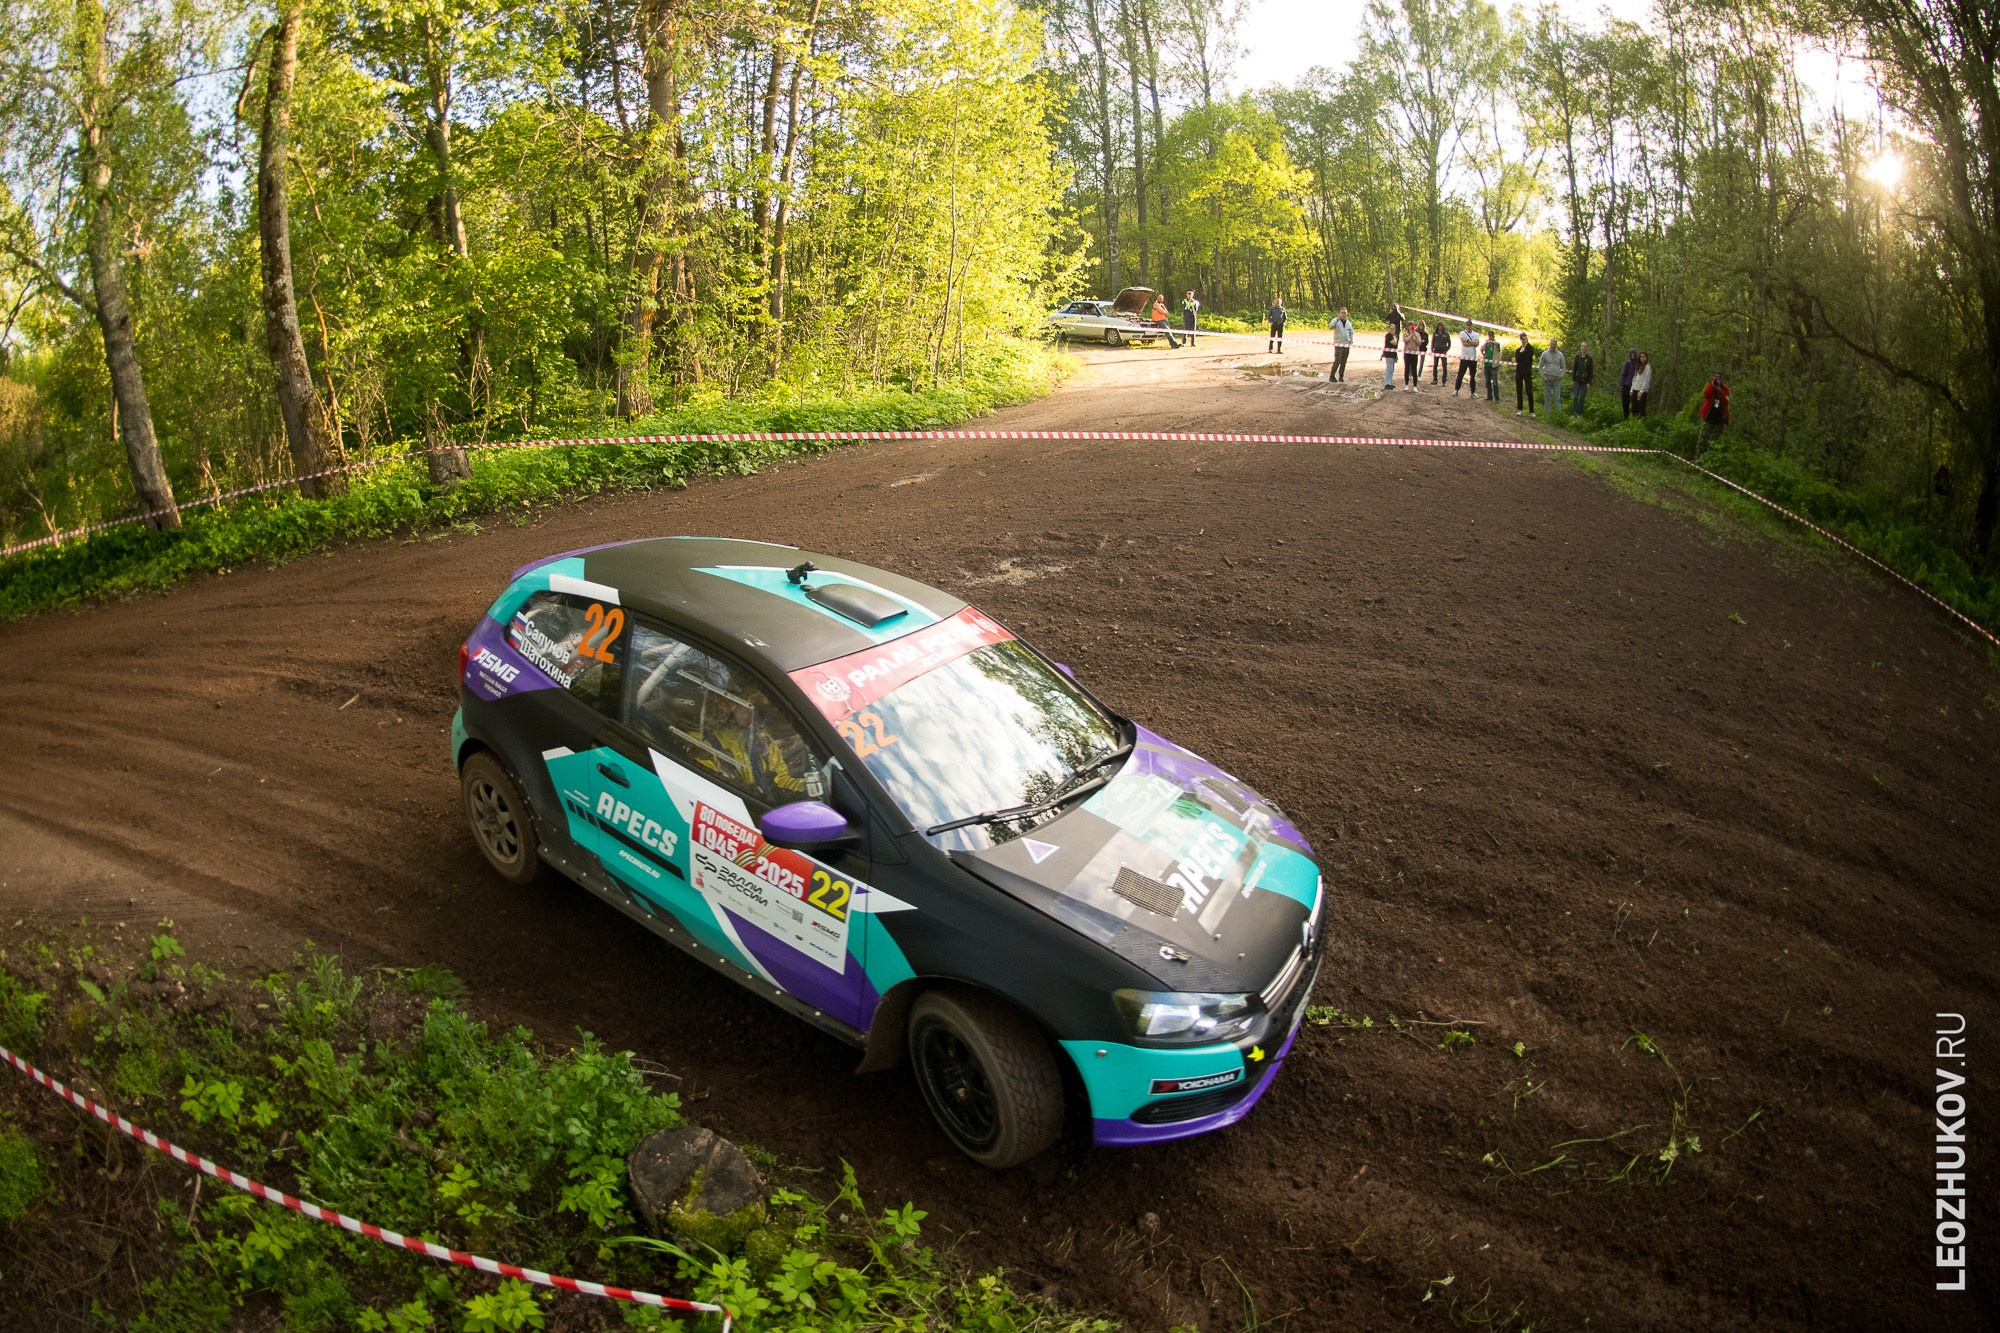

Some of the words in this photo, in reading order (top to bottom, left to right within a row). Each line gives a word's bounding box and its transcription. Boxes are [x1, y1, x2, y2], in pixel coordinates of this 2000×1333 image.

[525, 620, 571, 664] Сапунов
[578, 603, 624, 664] 22
[519, 636, 572, 689] Шатохина
[847, 645, 918, 688] РАЛЛИ
[837, 711, 898, 759] 22
[597, 791, 679, 857] APECS
[698, 823, 738, 860] 1945
[699, 804, 716, 827] 80
[713, 816, 758, 847] ПОБЕДА!
[755, 856, 805, 899] 2025
[1166, 822, 1239, 914] APECS
[807, 870, 853, 919] 22
[1178, 1072, 1235, 1091] YOKOHAMA
